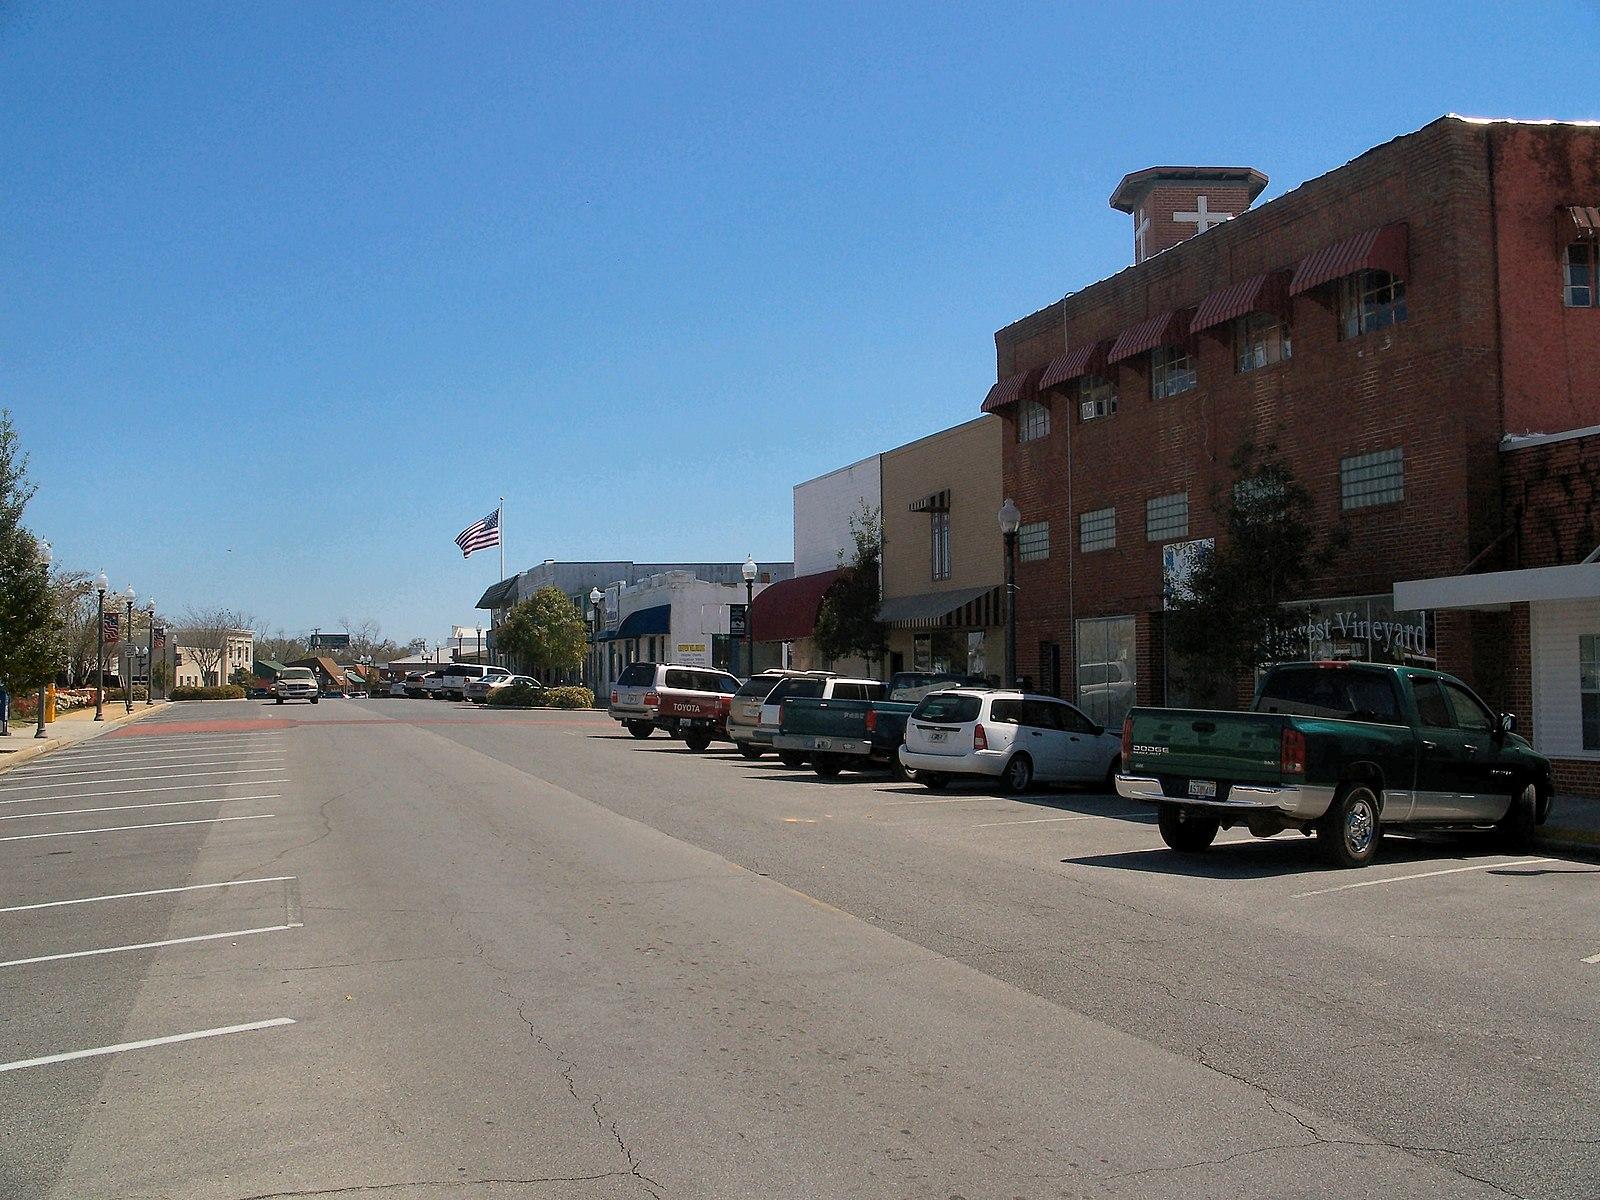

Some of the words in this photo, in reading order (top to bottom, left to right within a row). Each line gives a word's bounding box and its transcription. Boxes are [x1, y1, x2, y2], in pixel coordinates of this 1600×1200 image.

[1335, 611, 1428, 655] Vineyard
[673, 703, 701, 712] TOYOTA
[1133, 745, 1169, 753] DODGE
